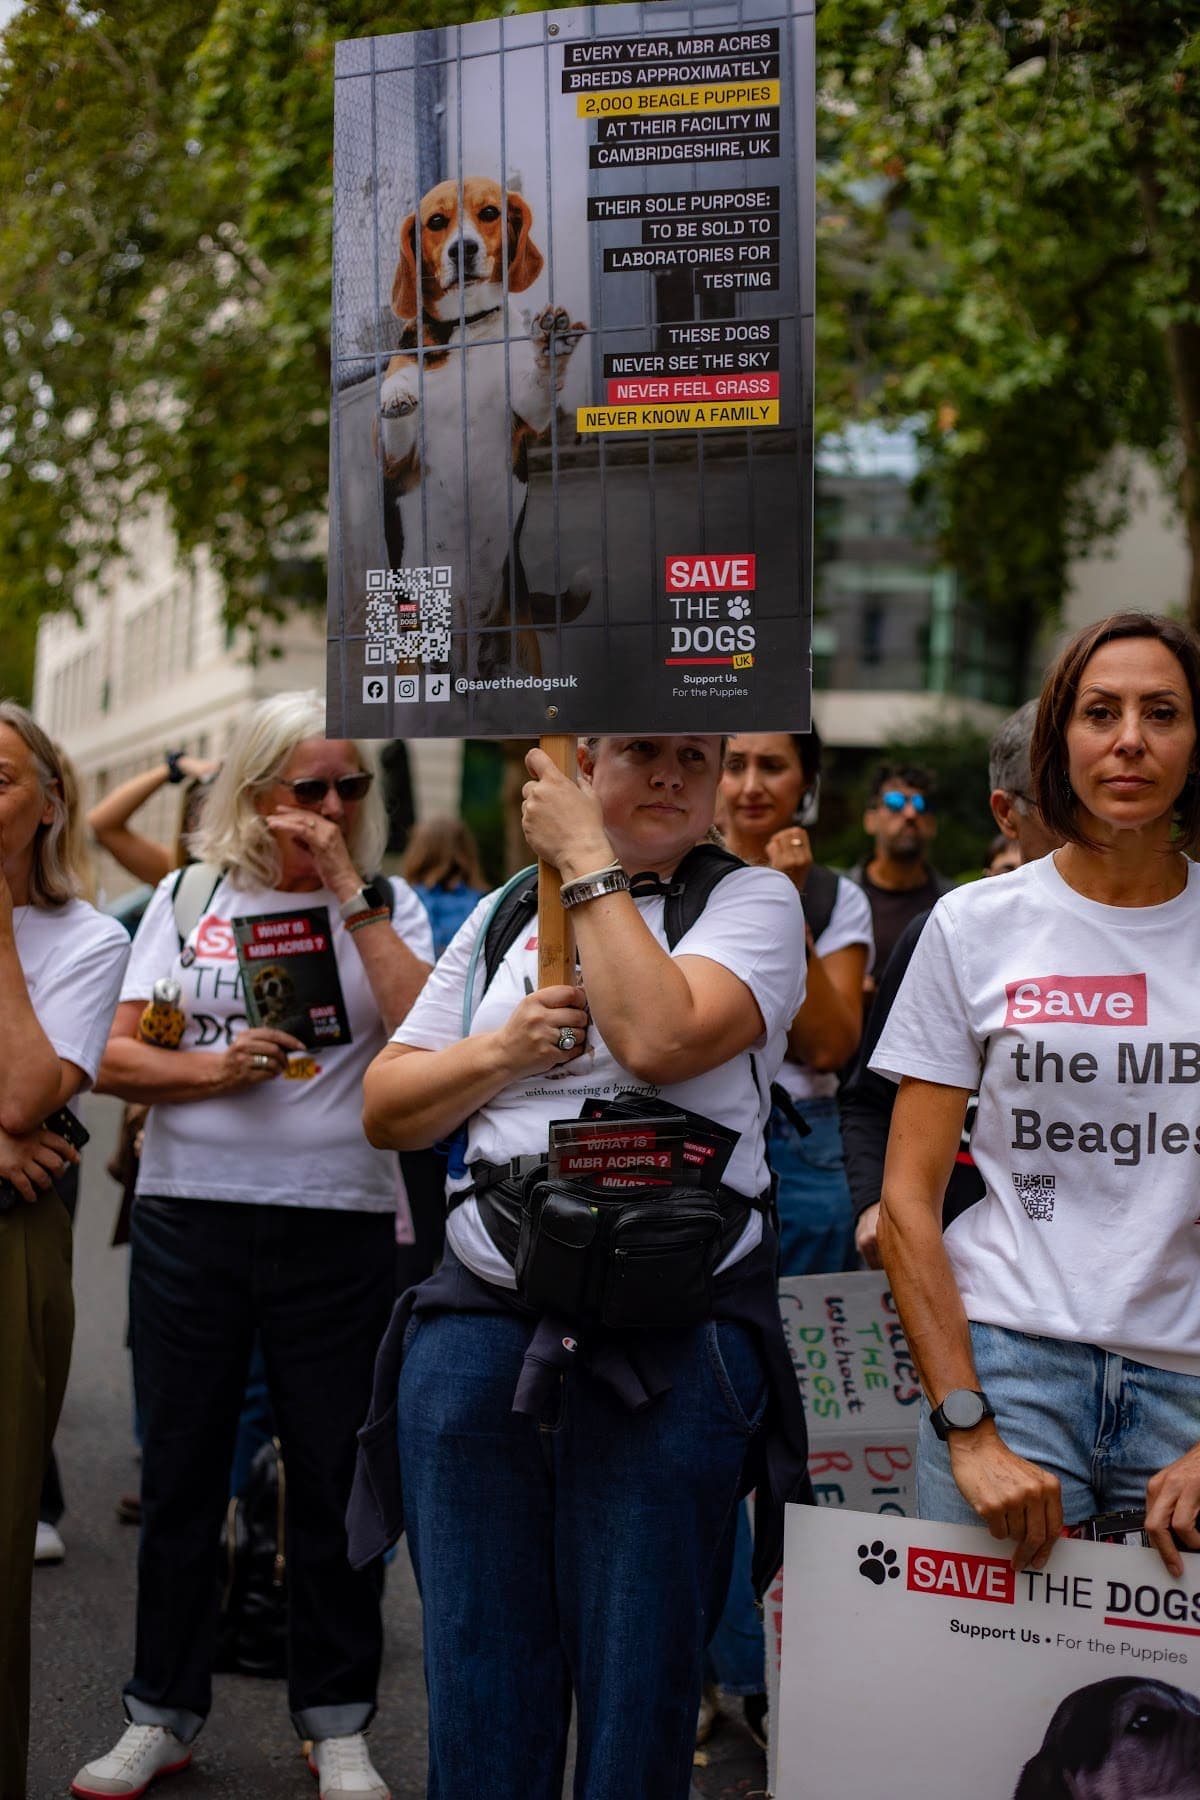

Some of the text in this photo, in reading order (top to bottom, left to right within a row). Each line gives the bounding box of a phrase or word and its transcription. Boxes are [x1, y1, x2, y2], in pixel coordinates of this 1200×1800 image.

[572, 34, 771, 63] EVERY YEAR, MBR ACRES
[570, 60, 771, 88] BREEDS APPROXIMATELY
[586, 87, 771, 114] 2,000 BEAGLE PUPPIES
[606, 112, 771, 137] AT THEIR FACILITY IN
[598, 139, 771, 164] CAMBRIDGESHIRE, UK
[595, 192, 771, 216] THEIR SOLE PURPOSE:
[650, 218, 771, 239] TO BE SOLD TO
[612, 245, 771, 267] LABORATORIES FOR
[703, 272, 771, 289] TESTING
[669, 325, 770, 344] THESE DOGS
[612, 352, 771, 373] NEVER SEE THE SKY
[617, 378, 770, 399] NEVER FEEL GRASS
[586, 406, 770, 426] NEVER KNOW A FAMILY
[670, 559, 749, 587] SAVE
[669, 598, 719, 619] THE
[670, 625, 756, 653] DOGS
[735, 656, 751, 667] UK
[455, 675, 578, 694] @savethedogsuk
[683, 674, 738, 685] Support Us
[672, 687, 749, 697] For the Puppies
[257, 922, 304, 938] WHAT IS
[249, 944, 275, 957] MBR
[278, 940, 313, 955] ACRES
[193, 966, 243, 999] TH
[1012, 984, 1134, 1020] Save
[1010, 1041, 1098, 1084] the
[567, 1085, 601, 1097] seeing
[603, 1085, 610, 1094] a
[613, 1082, 661, 1097] butterfly
[587, 1136, 648, 1150] WHAT IS
[1011, 1108, 1200, 1166] Beagle
[569, 1155, 668, 1169] MBR ACRES ?
[824, 1297, 864, 1414] without
[856, 1322, 889, 1390] THE
[800, 1326, 841, 1419] DOGS
[912, 1556, 1007, 1598] SAVE
[1021, 1570, 1093, 1609] THE
[950, 1619, 1188, 1665] Support Us For the Puppies
